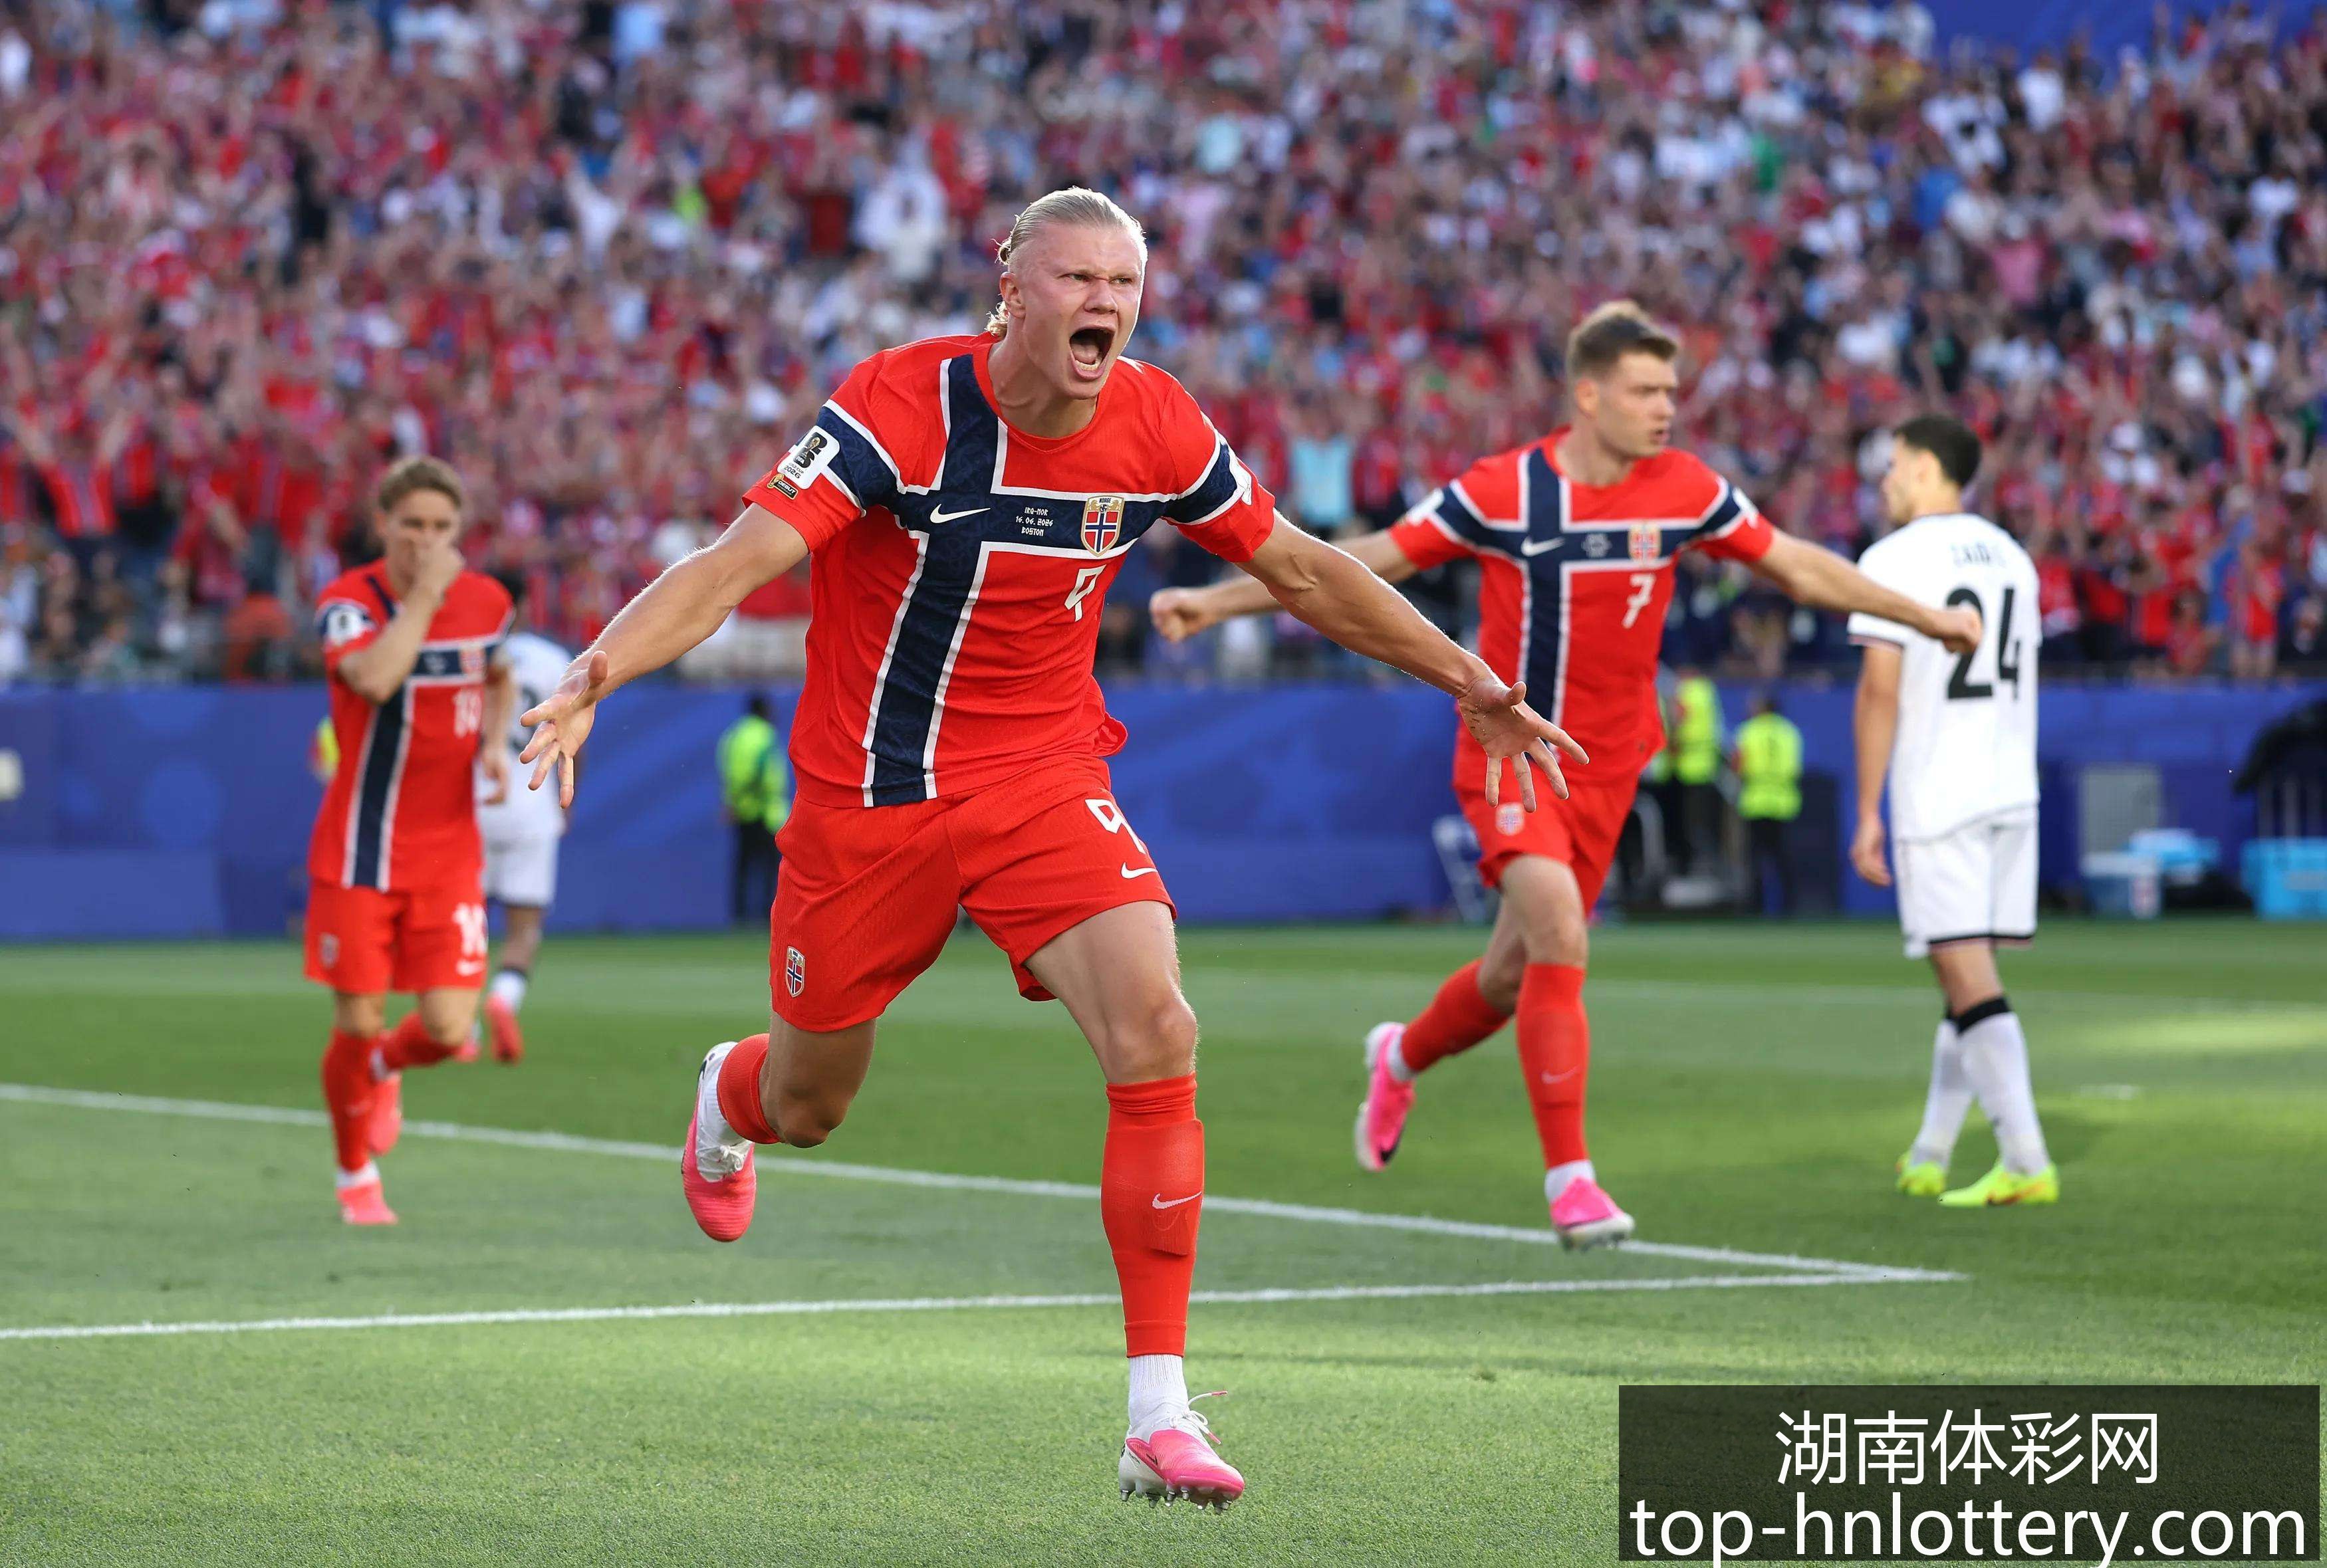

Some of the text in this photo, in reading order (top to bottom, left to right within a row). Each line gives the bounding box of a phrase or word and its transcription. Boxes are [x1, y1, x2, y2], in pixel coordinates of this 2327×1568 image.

[777, 480, 796, 494] DEBUT
[784, 465, 801, 479] 2026
[1021, 526, 1044, 537] BOSTON
[1065, 564, 1107, 622] 9
[1622, 573, 1656, 628] 7
[1945, 587, 2021, 702] 24
[1084, 799, 1147, 855] 9
